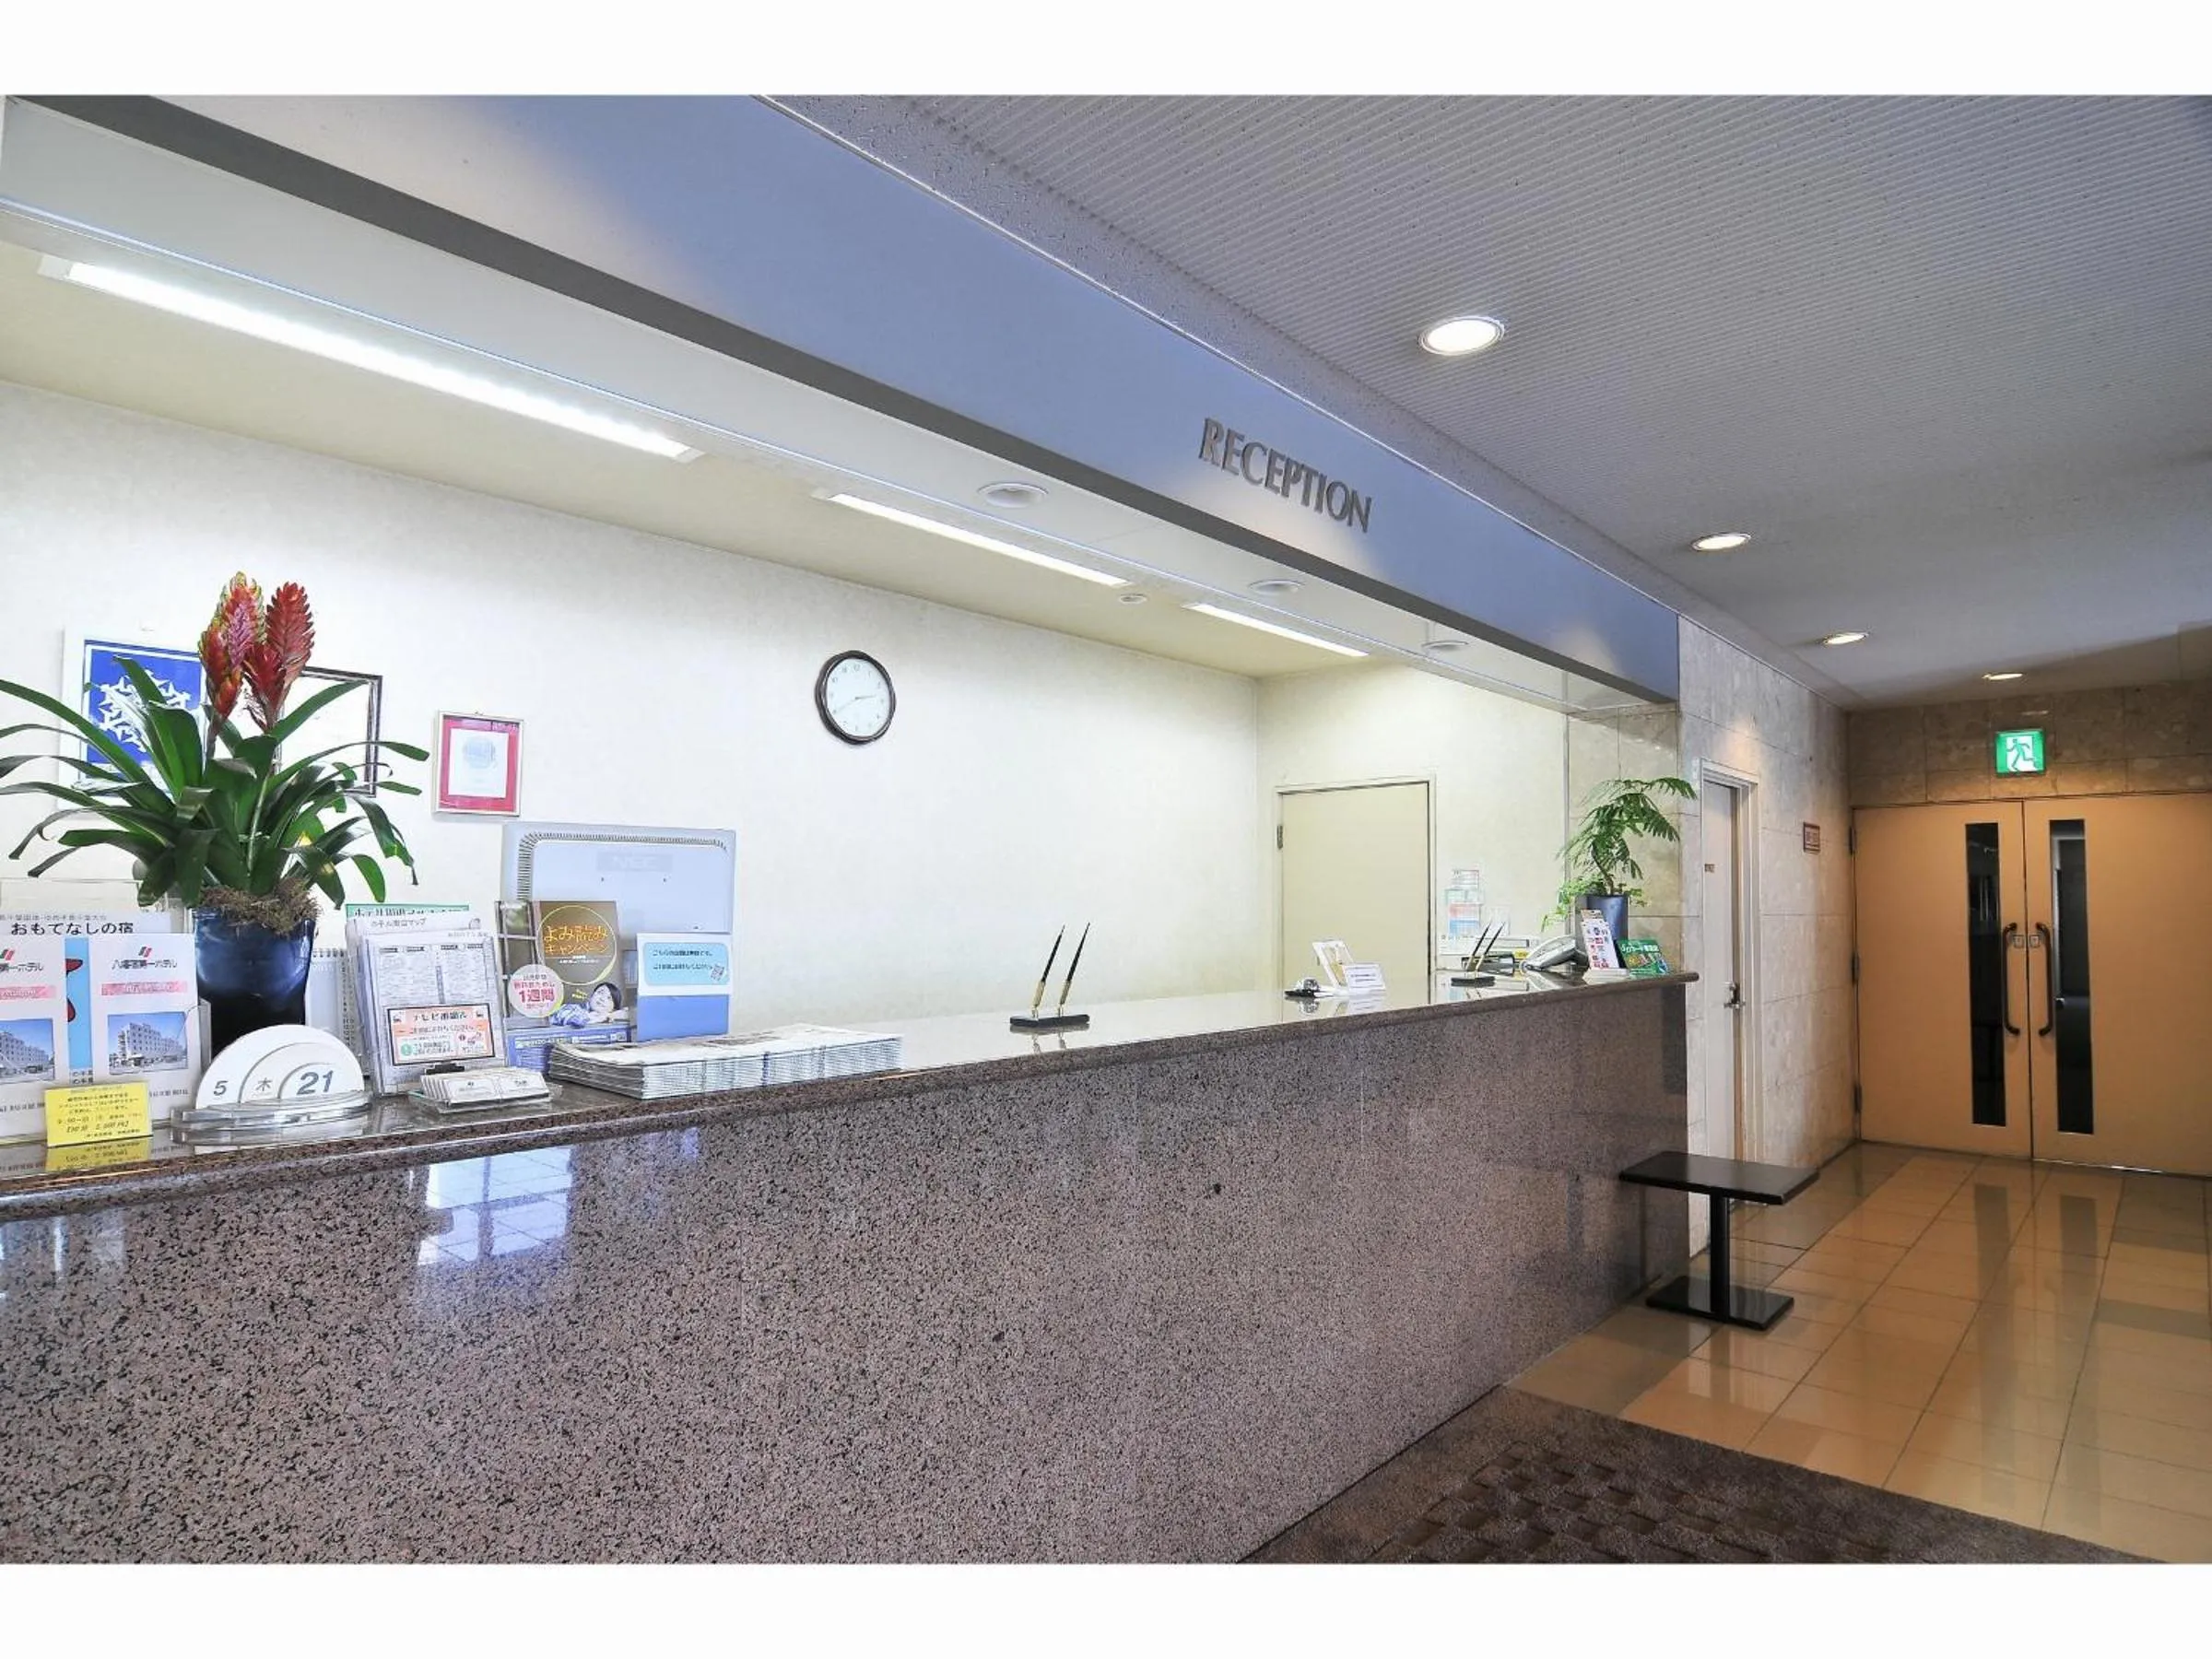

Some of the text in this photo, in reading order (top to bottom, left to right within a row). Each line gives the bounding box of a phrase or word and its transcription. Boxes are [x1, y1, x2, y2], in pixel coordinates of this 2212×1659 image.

[1198, 418, 1372, 533] RECEPTION
[11, 922, 135, 935] おもてなしの宿
[519, 989, 555, 1004] 1週間
[213, 1069, 335, 1096] 5 木 21
